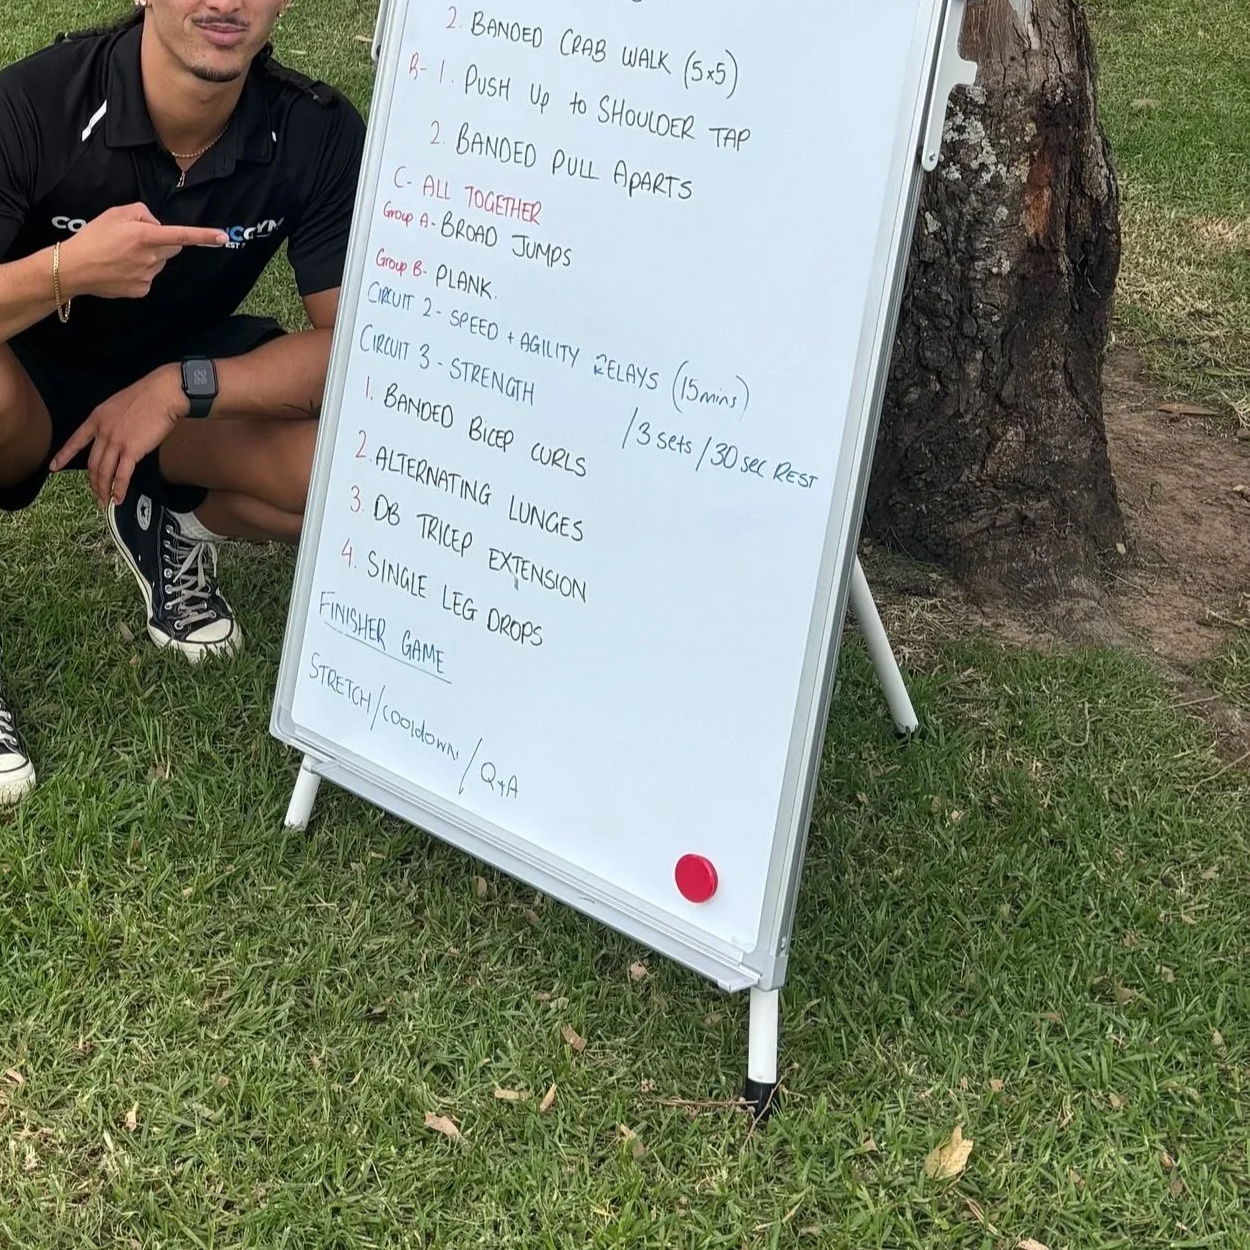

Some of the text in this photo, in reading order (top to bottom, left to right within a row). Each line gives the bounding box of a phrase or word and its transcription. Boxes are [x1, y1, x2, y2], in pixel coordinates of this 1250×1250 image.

[470, 10, 543, 48] BANDED
[560, 28, 607, 63] CRAB
[621, 45, 672, 75] WALK
[456, 121, 537, 168] BANDED
[552, 149, 600, 180] PULL
[464, 63, 511, 101] PUSH
[597, 94, 696, 140] SHOULDER
[708, 127, 751, 152] TAP
[383, 200, 414, 228] Group
[440, 210, 498, 248] BROAD
[511, 234, 572, 269] JUMPS
[422, 174, 451, 200] ALL
[464, 185, 542, 226] TOGETHER
[375, 247, 408, 277] Group
[367, 281, 414, 311] CIRCUIT
[449, 309, 499, 341] SPEED
[520, 332, 580, 368] AGILITY
[359, 324, 410, 361] CIRCUIT
[449, 357, 535, 407] STRENGTH
[773, 461, 819, 489] REST
[383, 382, 454, 429] BANDED
[530, 442, 587, 477] CURLS
[375, 445, 493, 507] ALTERNATING
[509, 494, 584, 543] LUNGES
[373, 493, 401, 527] DB
[416, 513, 474, 558] TRICEP
[488, 547, 587, 604] EXTENSION
[319, 590, 445, 674] FINISHER GAME
[367, 550, 428, 600] SINGLE
[442, 583, 478, 622] LEG
[486, 607, 544, 647] DROPS
